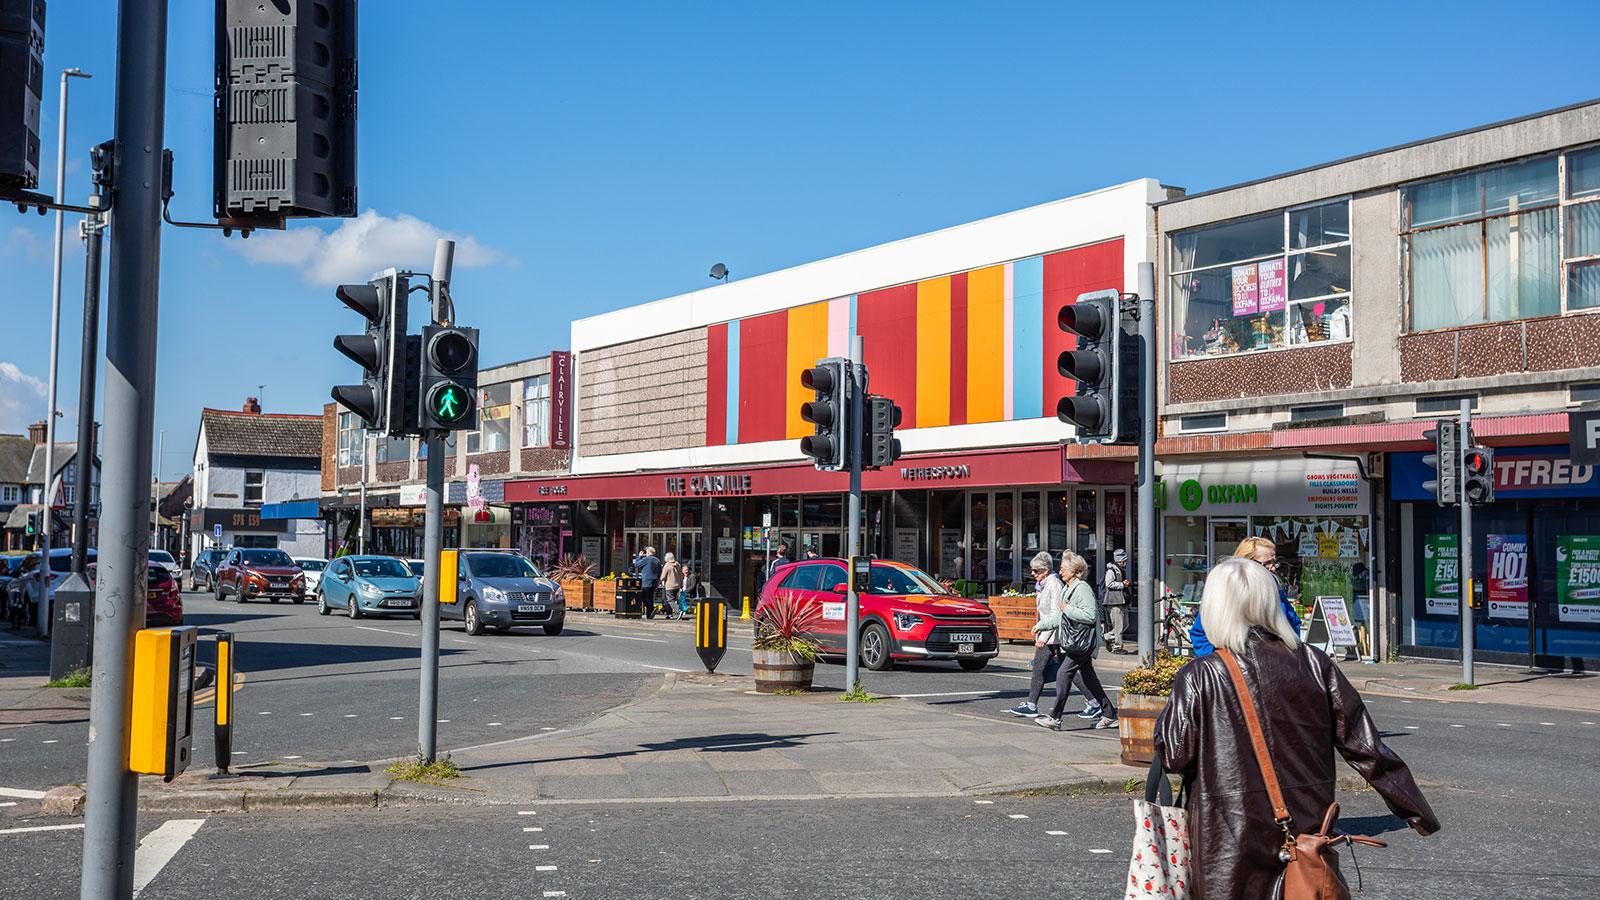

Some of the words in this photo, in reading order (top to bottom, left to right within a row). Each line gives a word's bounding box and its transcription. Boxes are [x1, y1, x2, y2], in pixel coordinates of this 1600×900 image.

[1234, 283, 1257, 293] BOOKS
[1261, 289, 1269, 298] TO
[1234, 299, 1253, 309] OXFAM
[1261, 295, 1280, 305] OXFAM
[901, 464, 970, 480] WETHERSPOON
[1494, 459, 1593, 486] TFRED
[664, 477, 686, 493] THE
[690, 474, 752, 493] CLAIRVILLE
[1207, 483, 1258, 504] OXFAM
[1491, 552, 1528, 580] HOT
